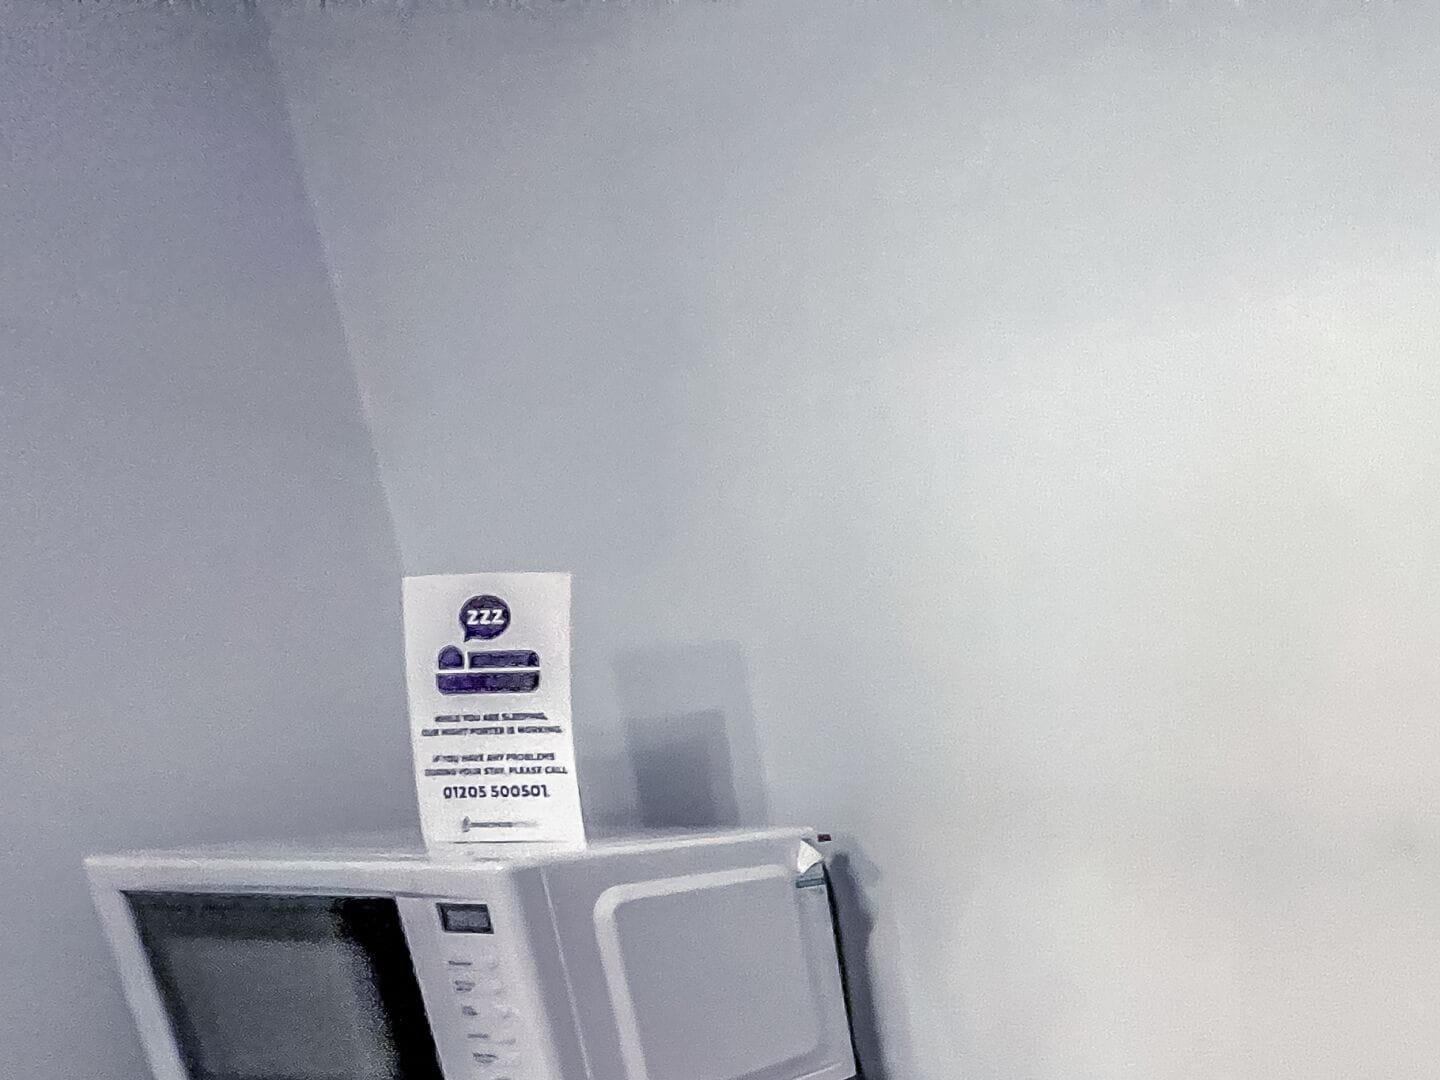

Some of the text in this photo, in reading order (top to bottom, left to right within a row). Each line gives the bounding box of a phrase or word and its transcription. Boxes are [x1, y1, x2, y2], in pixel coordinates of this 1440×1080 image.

[463, 714, 481, 722] YOU
[483, 713, 500, 721] ARE
[461, 754, 484, 762] HAVE
[487, 753, 504, 761] ANY
[506, 752, 555, 761] PROBLEMS
[459, 767, 481, 776] YOUR
[508, 766, 542, 774] PLEASE
[544, 766, 568, 774] CALL
[443, 785, 487, 799] 01205
